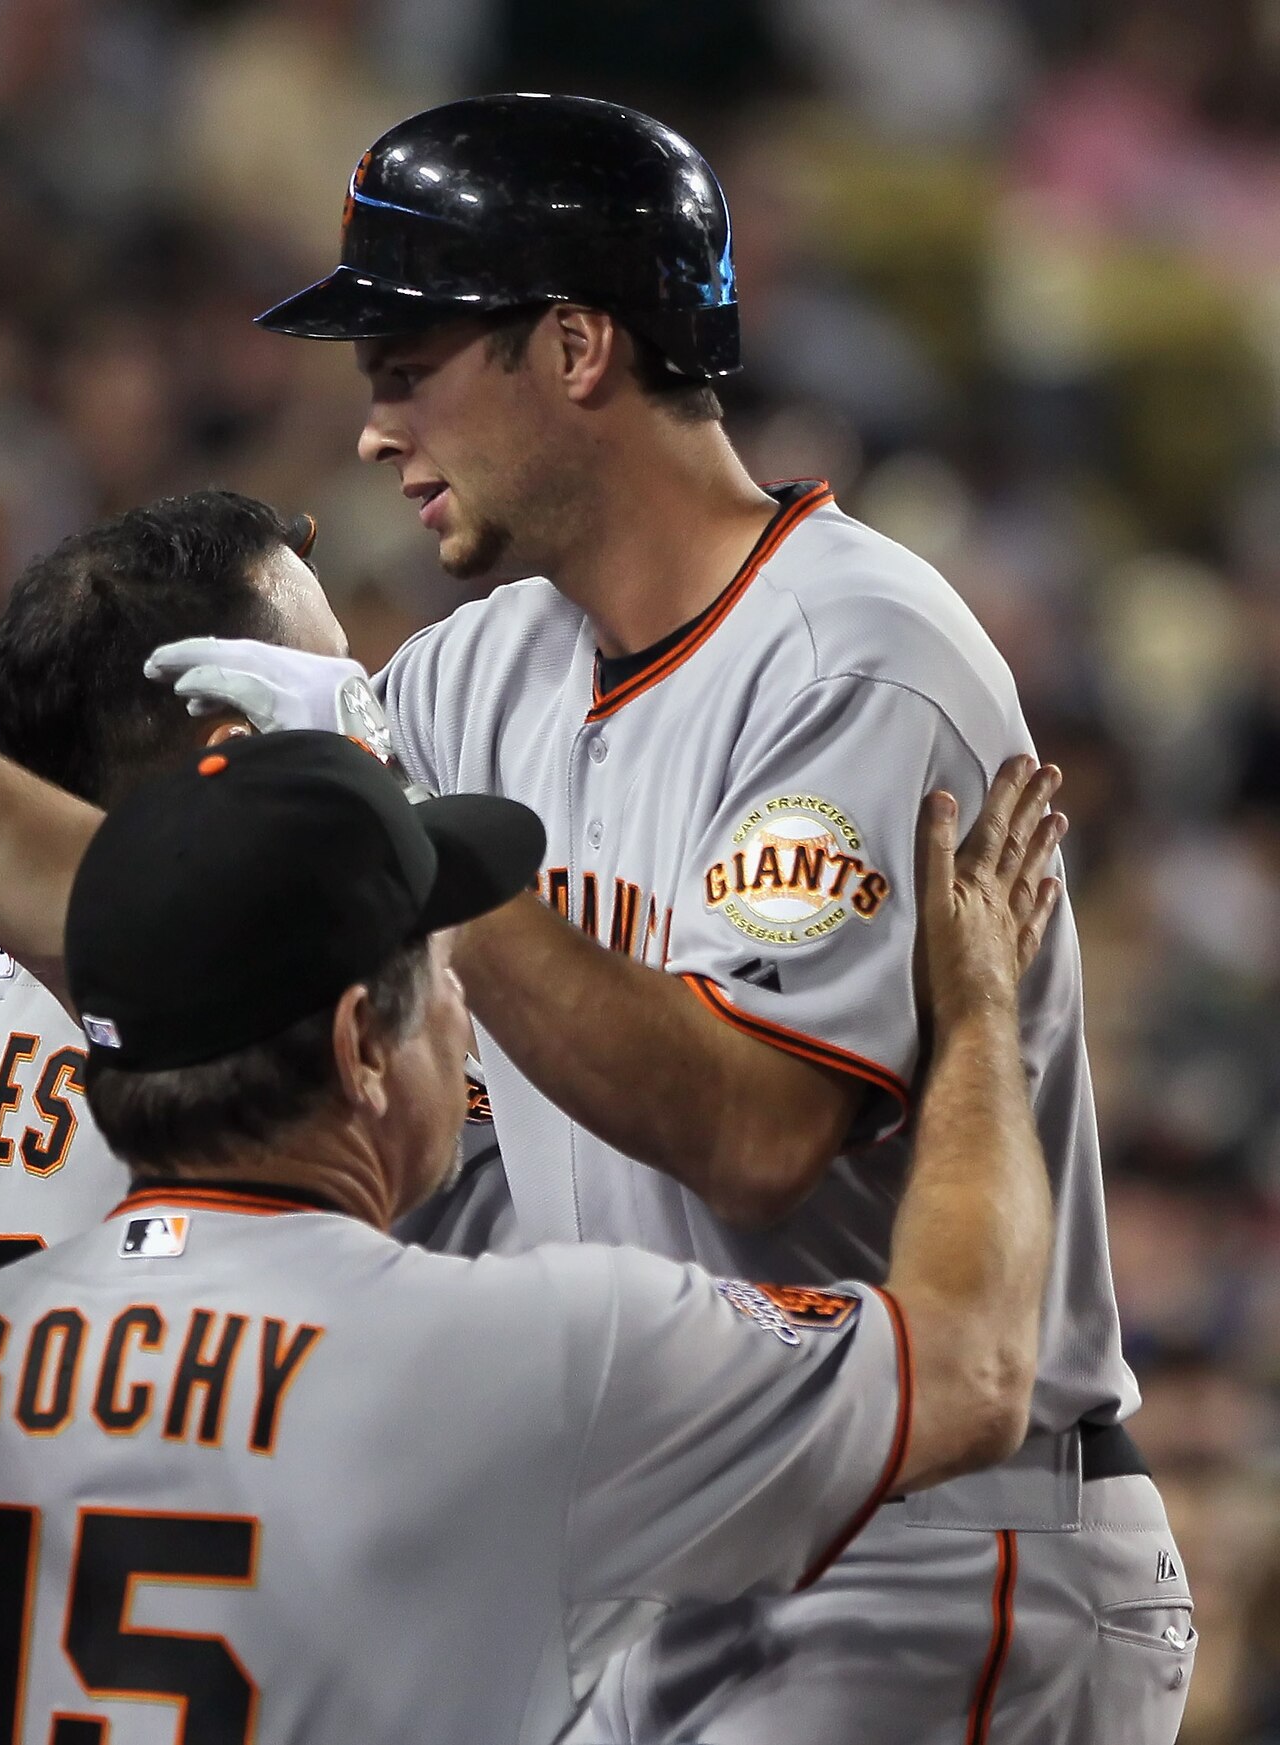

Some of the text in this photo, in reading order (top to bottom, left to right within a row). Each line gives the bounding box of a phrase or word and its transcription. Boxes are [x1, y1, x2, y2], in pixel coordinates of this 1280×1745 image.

[732, 796, 861, 850] SAN FRANCISCO
[703, 845, 890, 920] GIANTS
[724, 903, 846, 944] BASEBALL CLUB
